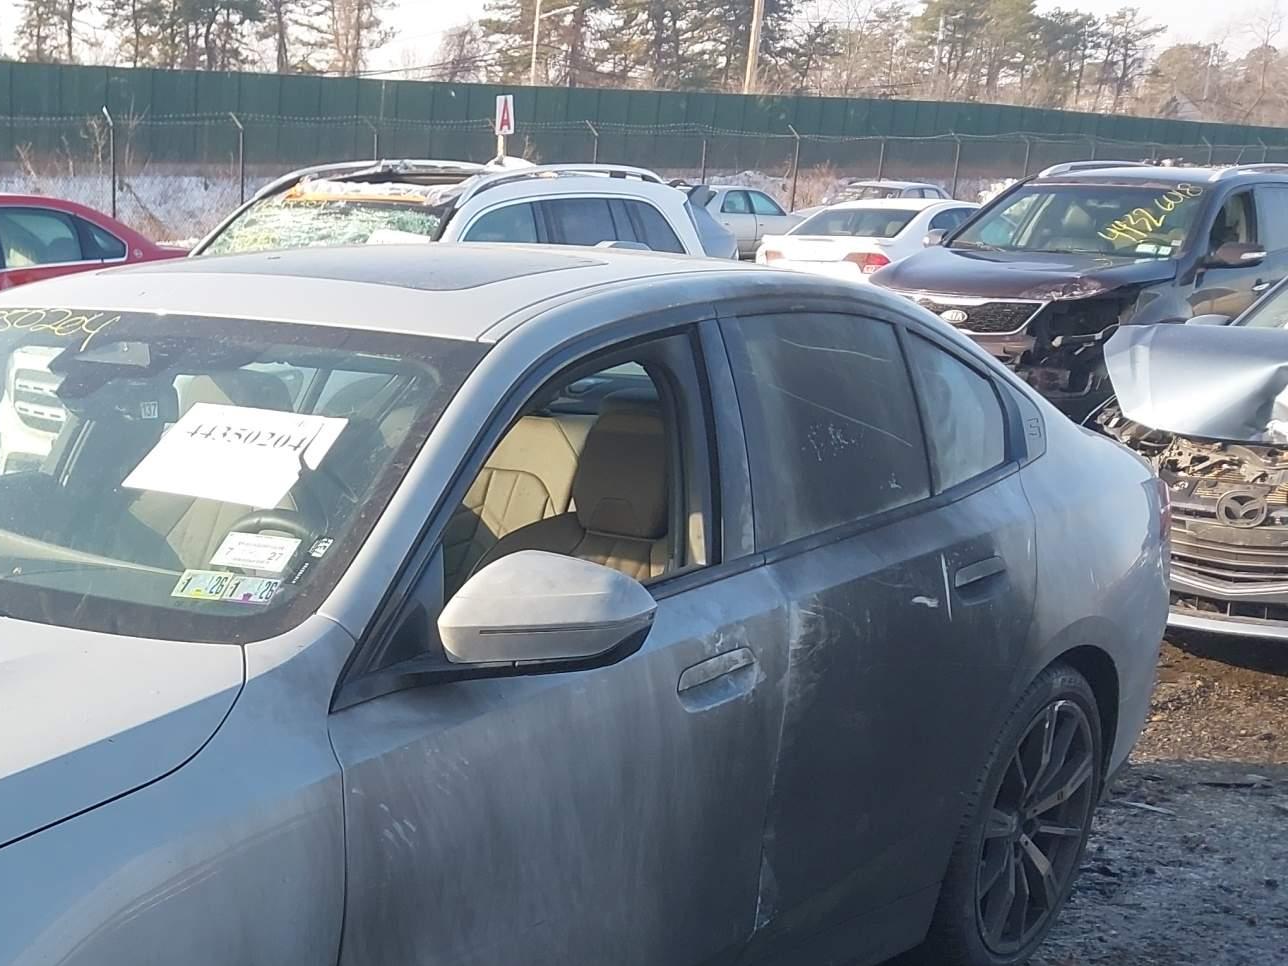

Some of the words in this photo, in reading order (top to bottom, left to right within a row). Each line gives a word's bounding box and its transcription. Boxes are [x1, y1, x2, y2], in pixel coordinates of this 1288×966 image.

[499, 95, 511, 131] A
[187, 424, 308, 451] 44350204
[209, 576, 229, 594] 26
